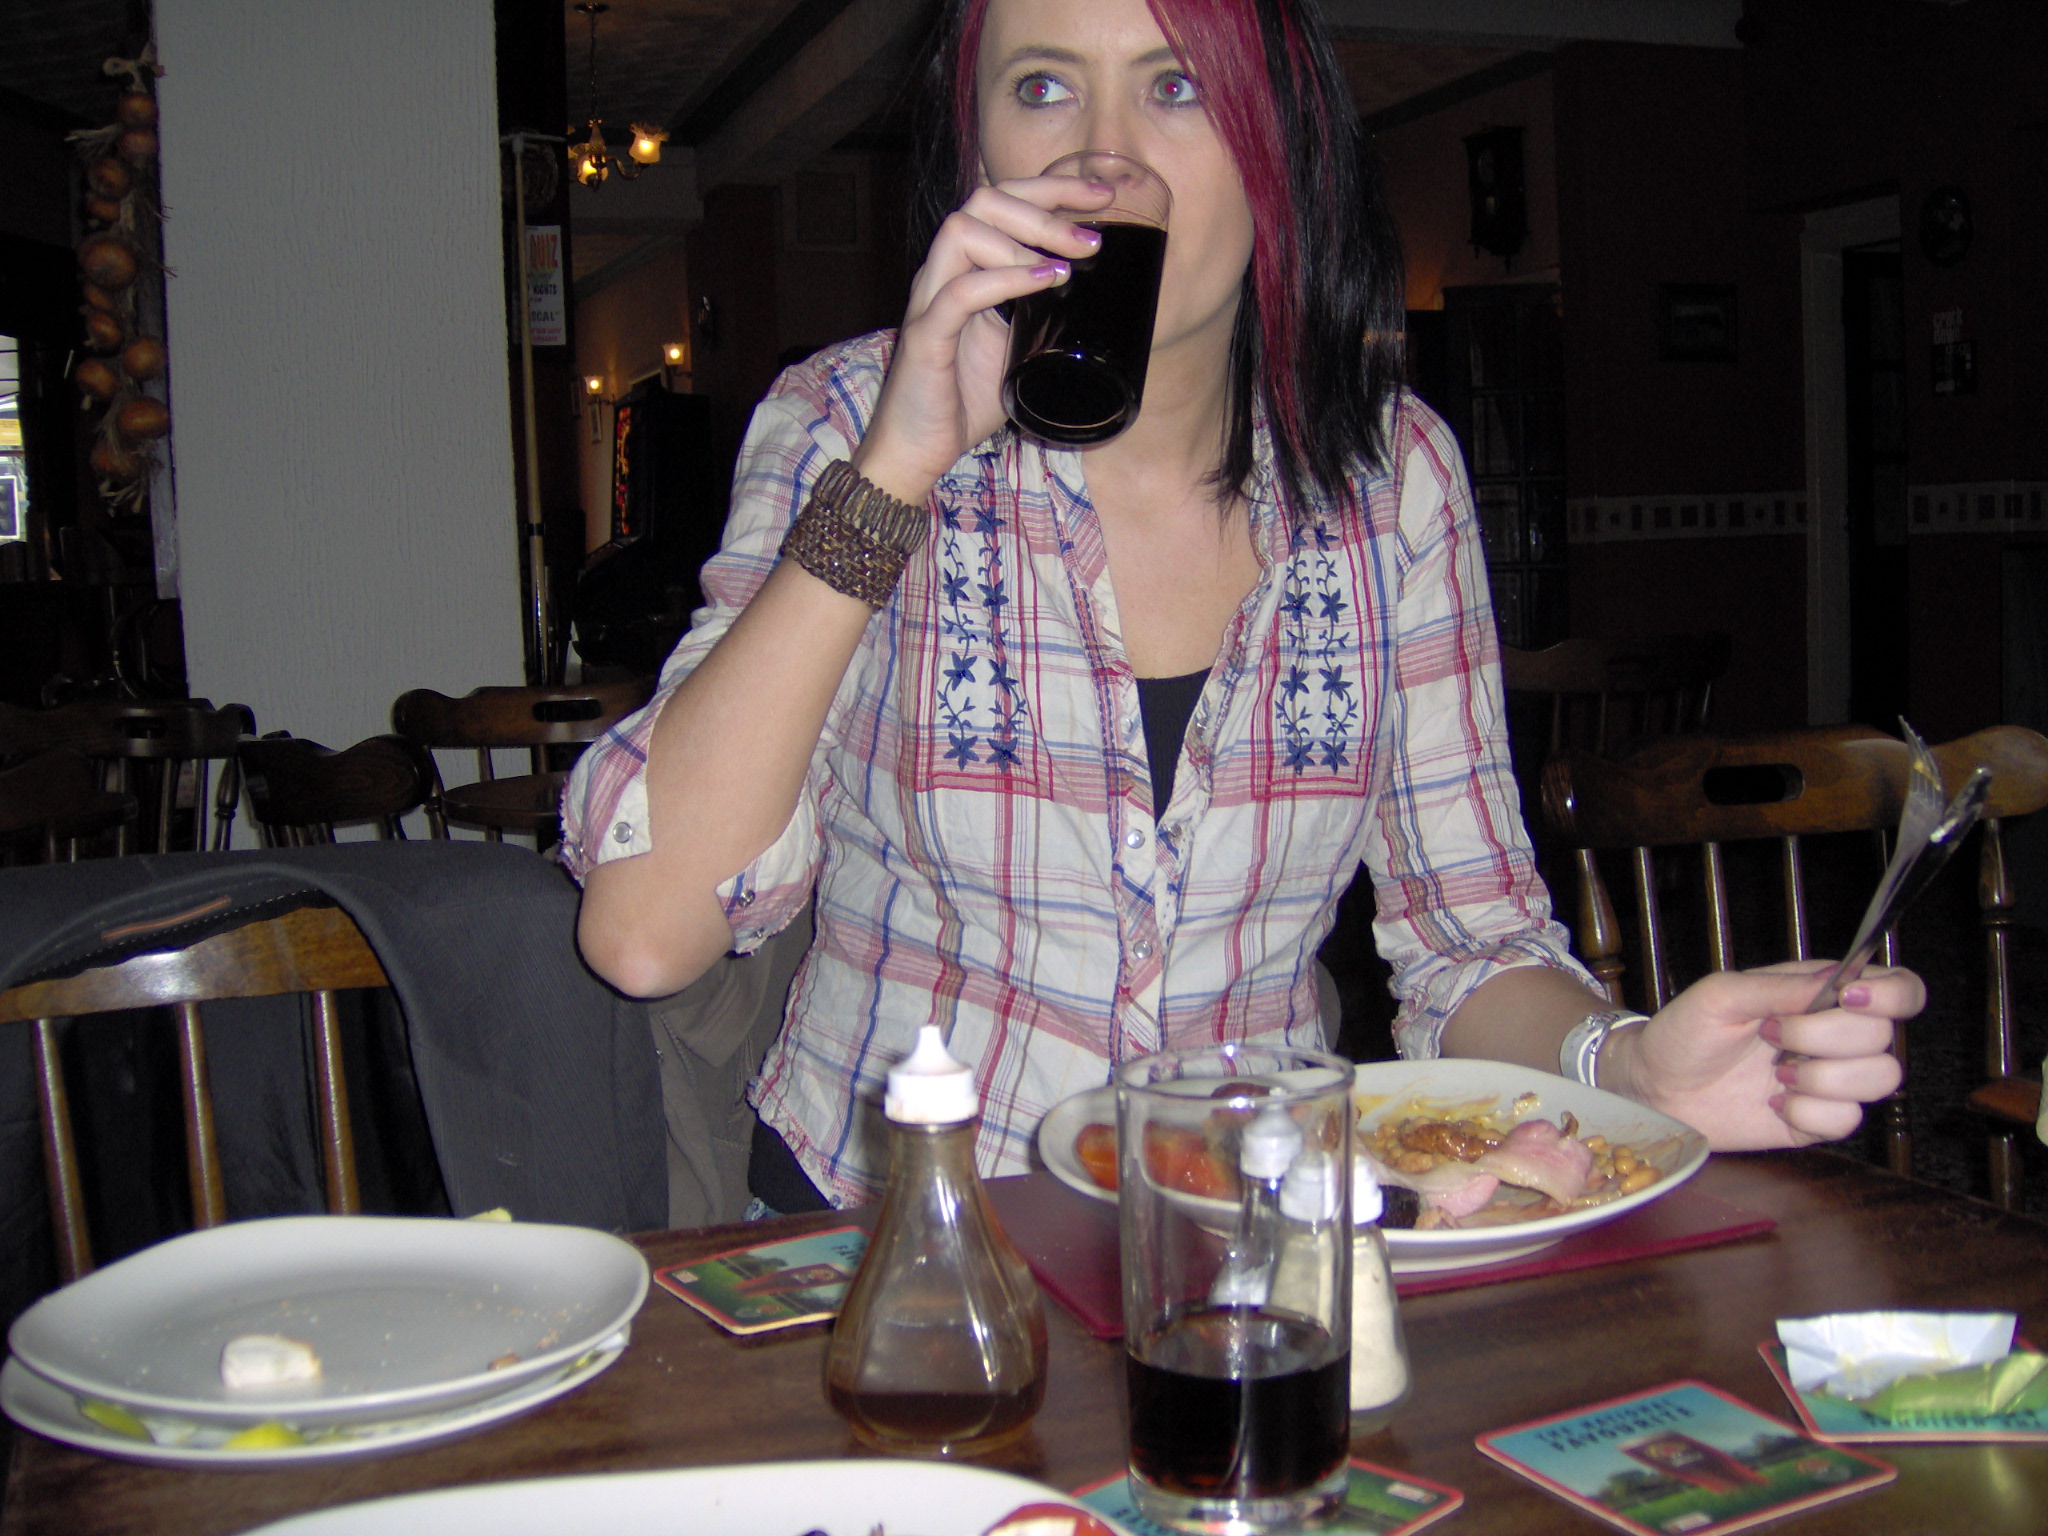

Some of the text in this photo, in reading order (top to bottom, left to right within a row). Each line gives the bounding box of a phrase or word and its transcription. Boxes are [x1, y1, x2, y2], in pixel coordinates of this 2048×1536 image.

[530, 234, 558, 269] QUIZ
[533, 284, 557, 295] NIGHTS
[1549, 1405, 1696, 1452] FAVOURITE
